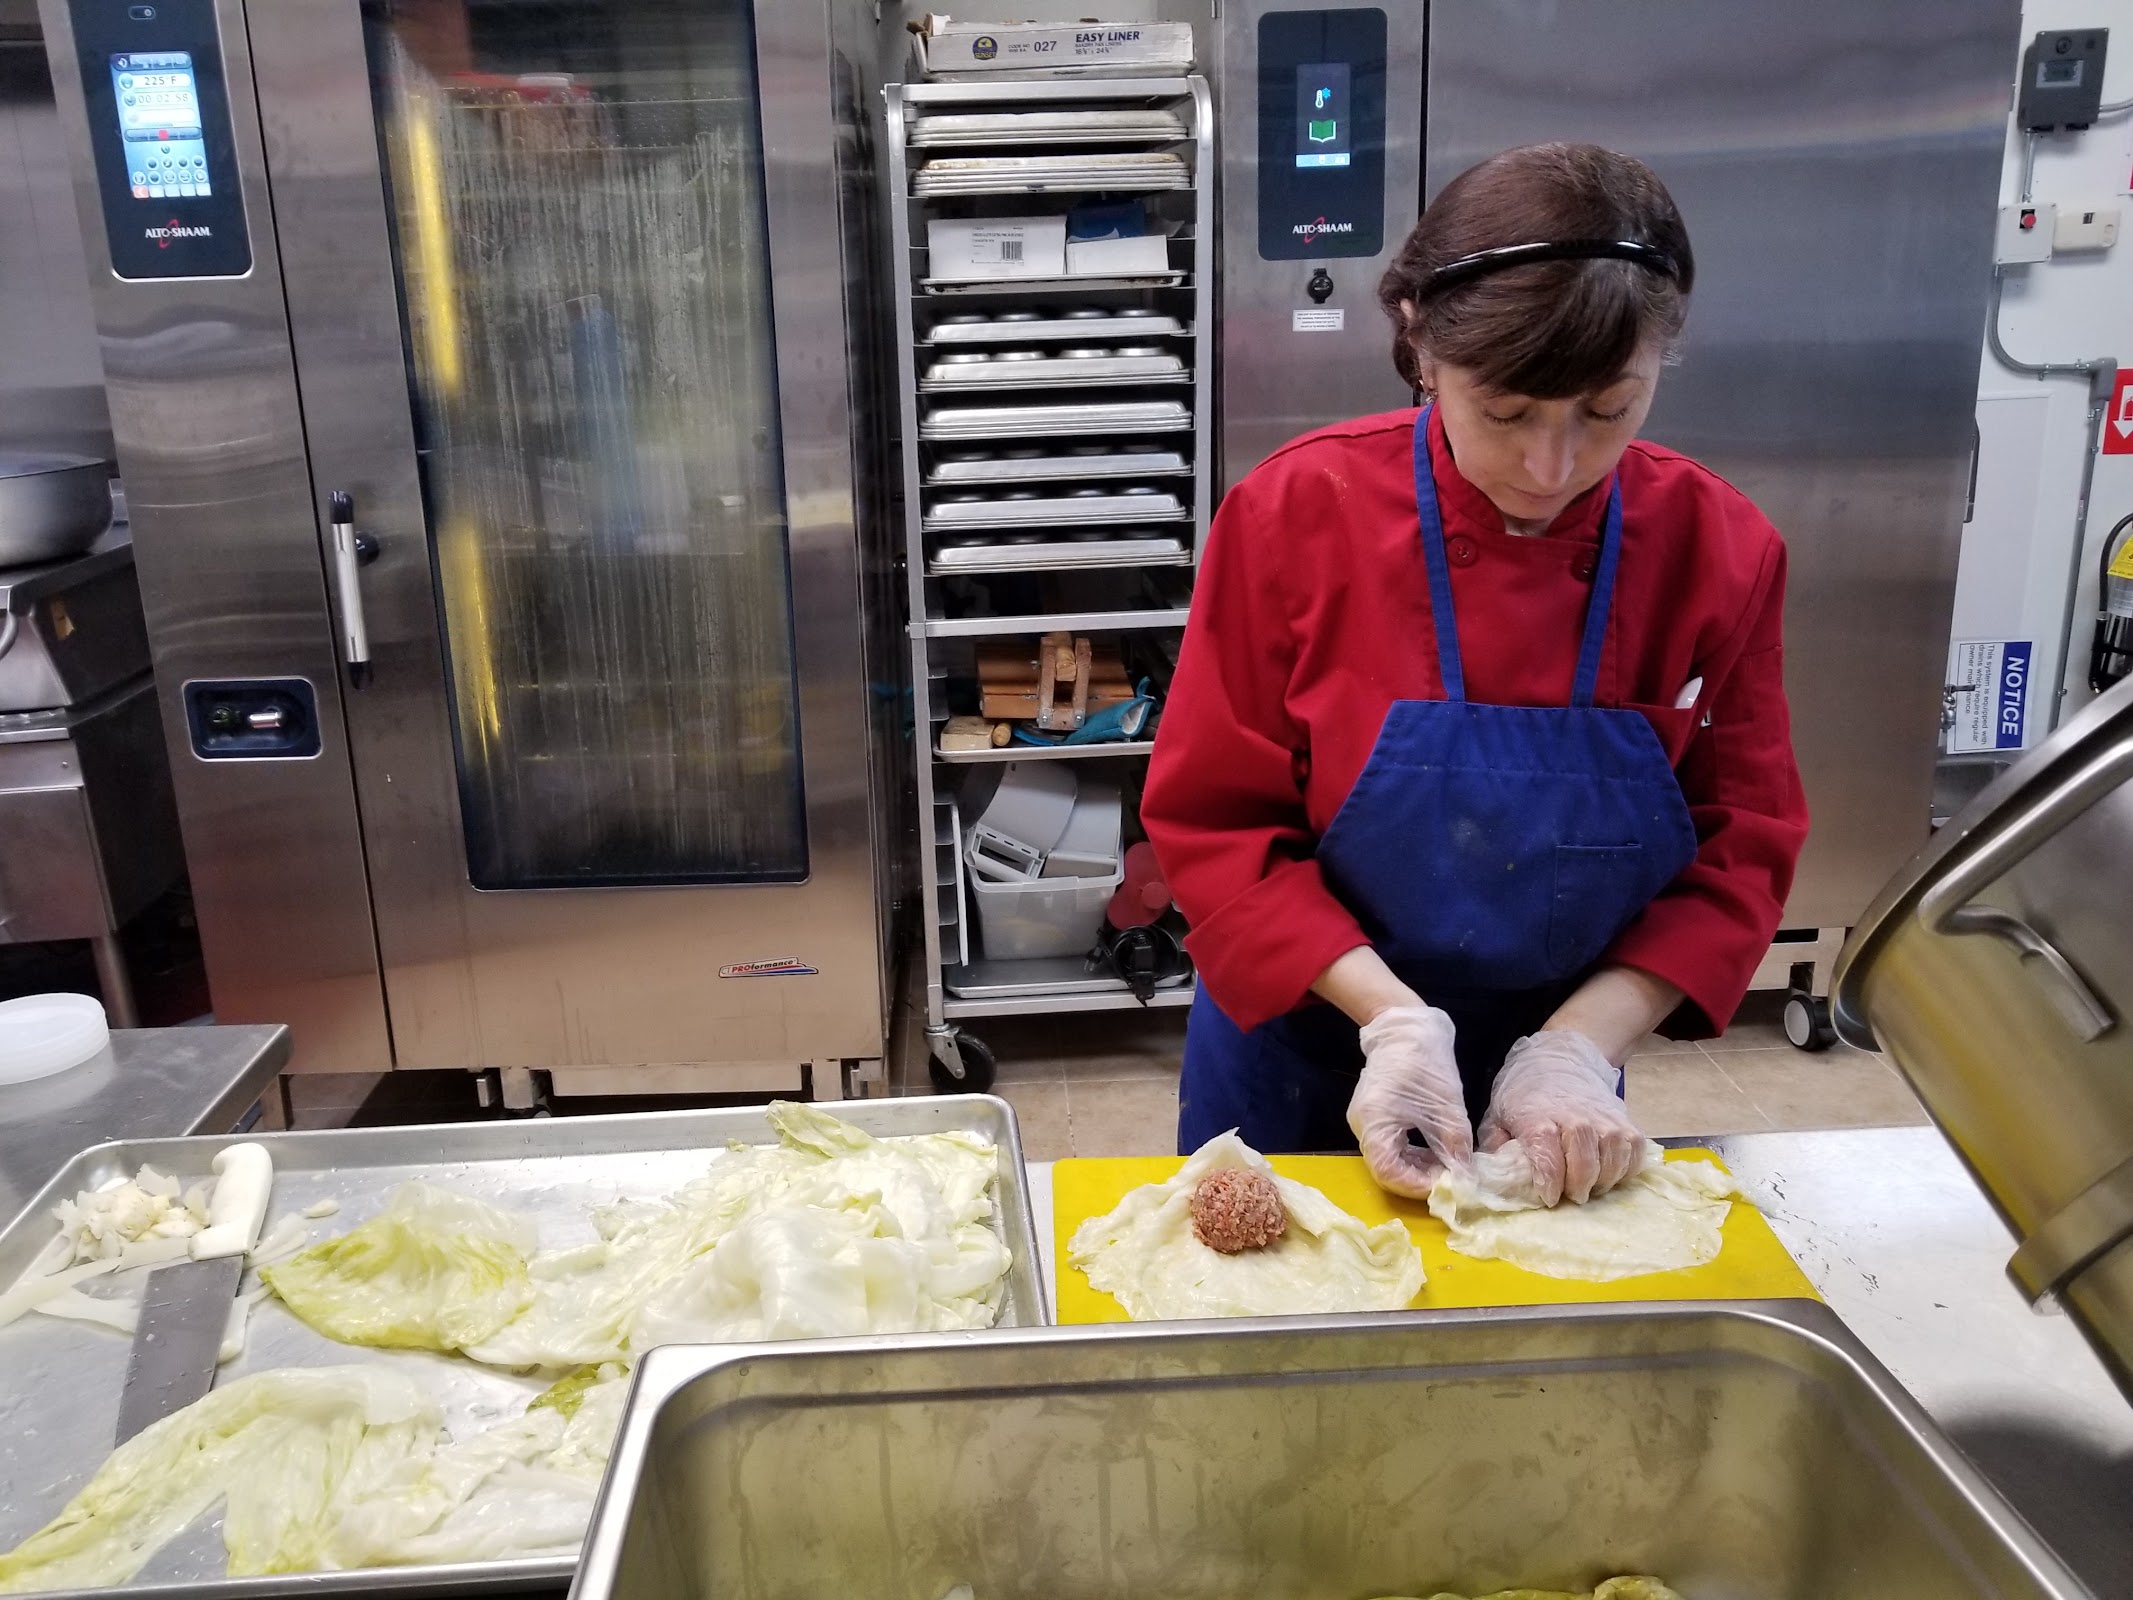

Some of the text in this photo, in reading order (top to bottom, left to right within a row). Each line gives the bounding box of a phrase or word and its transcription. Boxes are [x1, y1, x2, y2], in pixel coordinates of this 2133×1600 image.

[1076, 31, 1140, 42] EASY LINER
[1034, 41, 1057, 52] 027
[145, 226, 210, 239] ALTO-SHAAM
[1292, 223, 1352, 234] ALTO-SHAAM
[1987, 644, 1995, 660] This
[1984, 661, 1992, 687] system
[1971, 644, 1985, 742] drains which require regular
[2001, 656, 2025, 736] NOTICE
[1981, 696, 1989, 729] equipped
